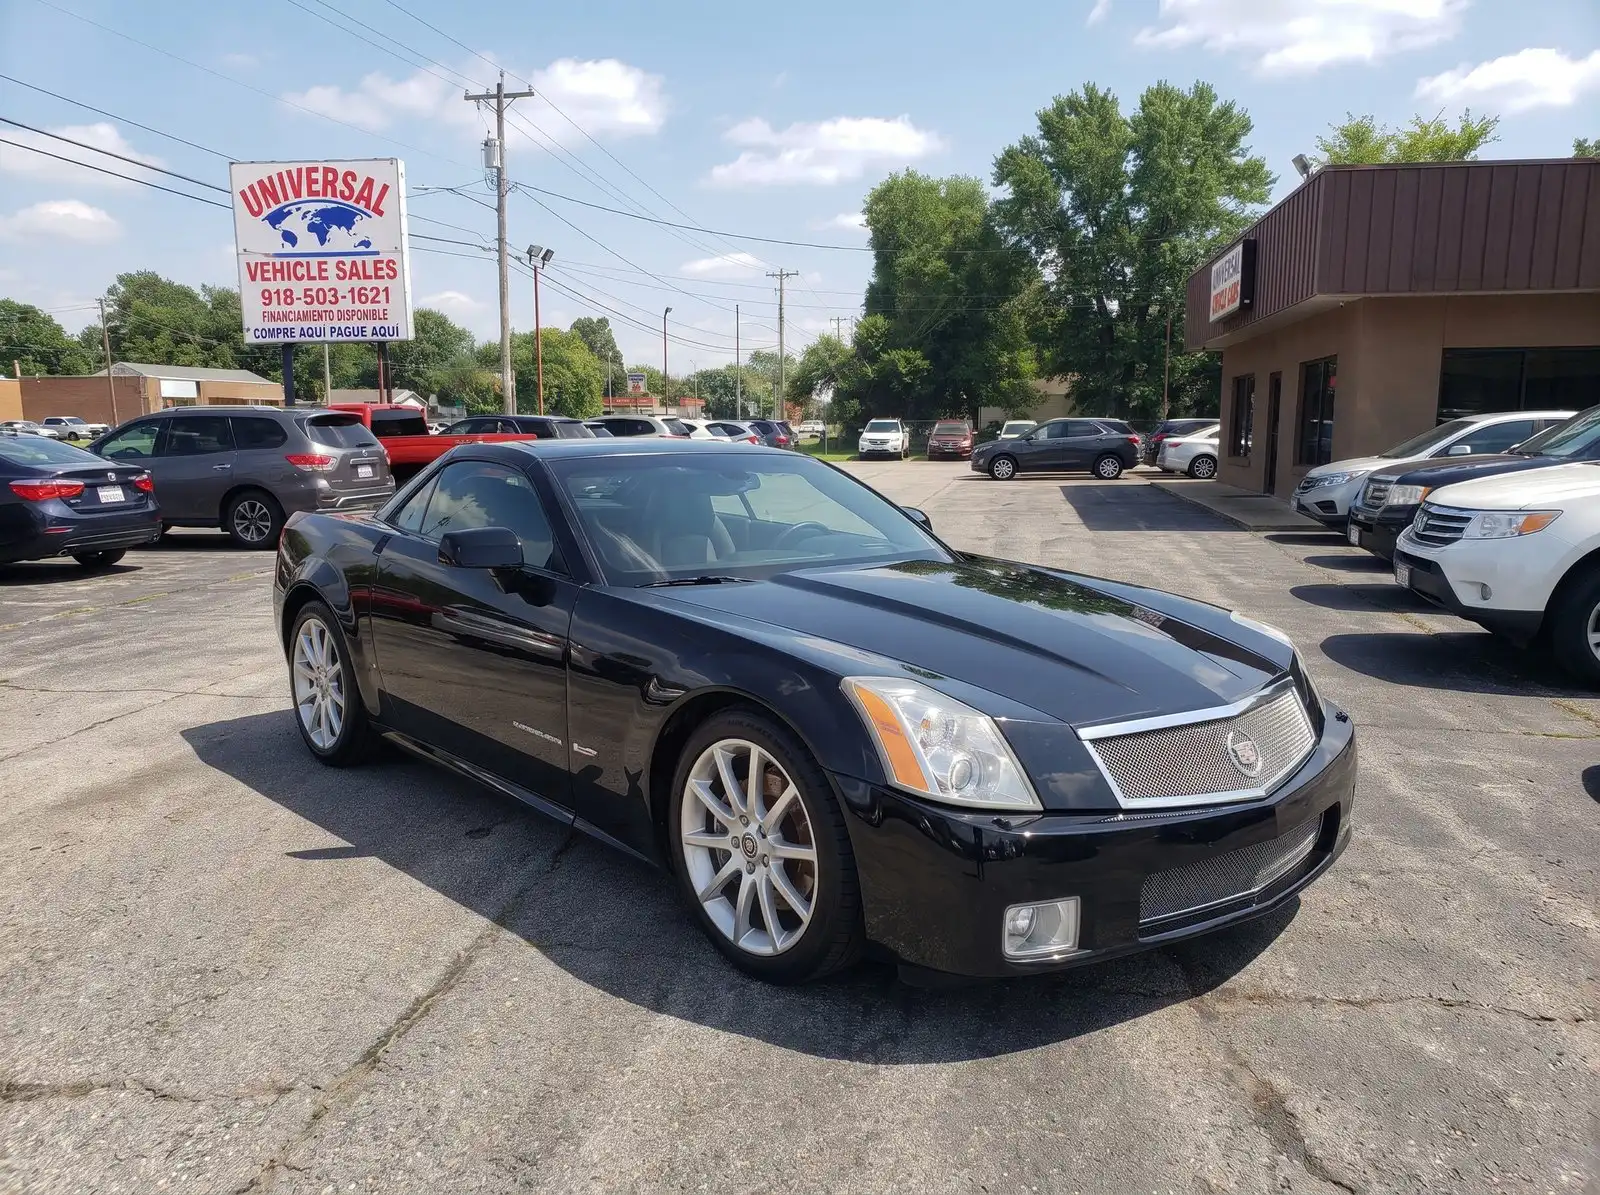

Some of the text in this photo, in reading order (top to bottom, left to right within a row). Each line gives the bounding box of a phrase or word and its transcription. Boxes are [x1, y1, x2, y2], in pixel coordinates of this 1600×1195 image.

[238, 166, 390, 218] UNIVERSAL
[246, 259, 398, 282] VEHICLE SALES
[261, 286, 391, 307] 918-503-1621
[262, 308, 388, 323] FINANCIAMIENTO DISPONIBLE
[253, 327, 296, 339] COMPRE
[329, 325, 367, 338] PAGUE
